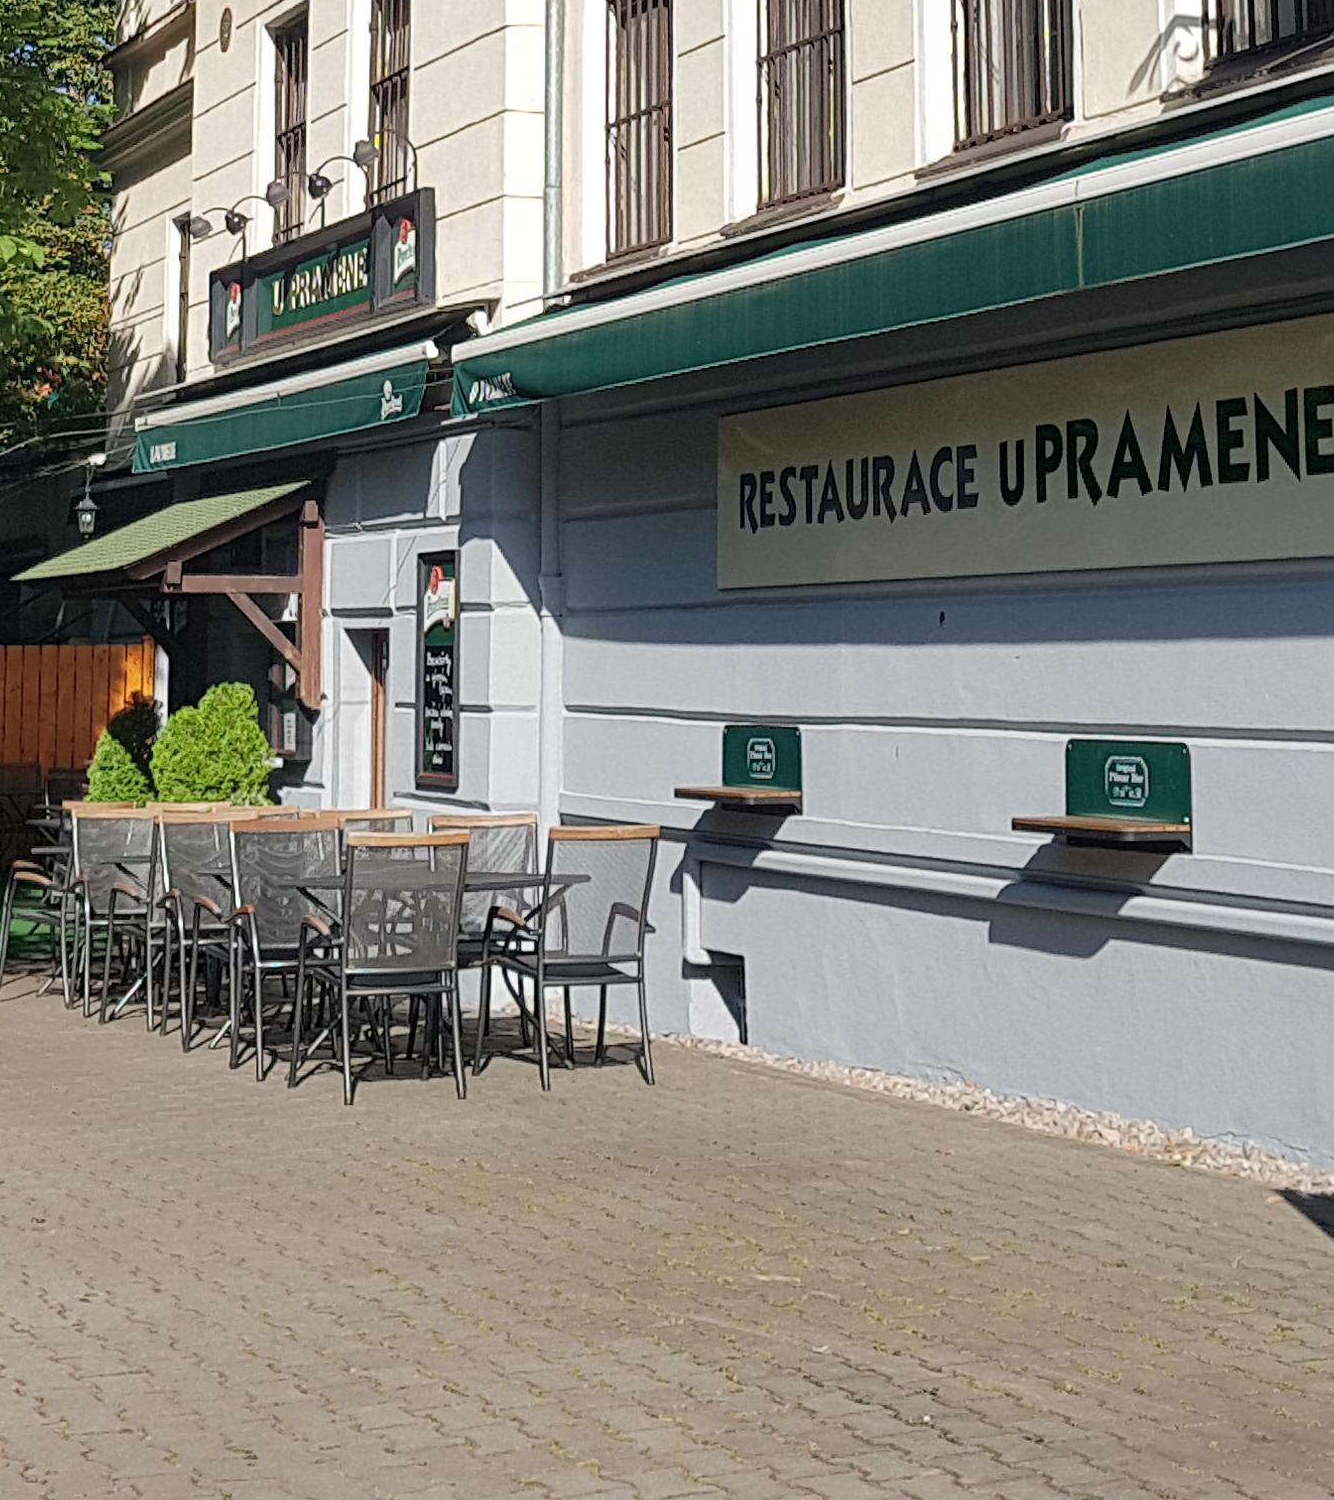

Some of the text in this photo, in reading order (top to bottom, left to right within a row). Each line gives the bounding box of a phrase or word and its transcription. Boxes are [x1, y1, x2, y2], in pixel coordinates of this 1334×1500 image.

[272, 279, 285, 316] U
[289, 248, 368, 310] PRAMENE
[739, 444, 980, 534] RESTAURACE
[999, 439, 1026, 506] U
